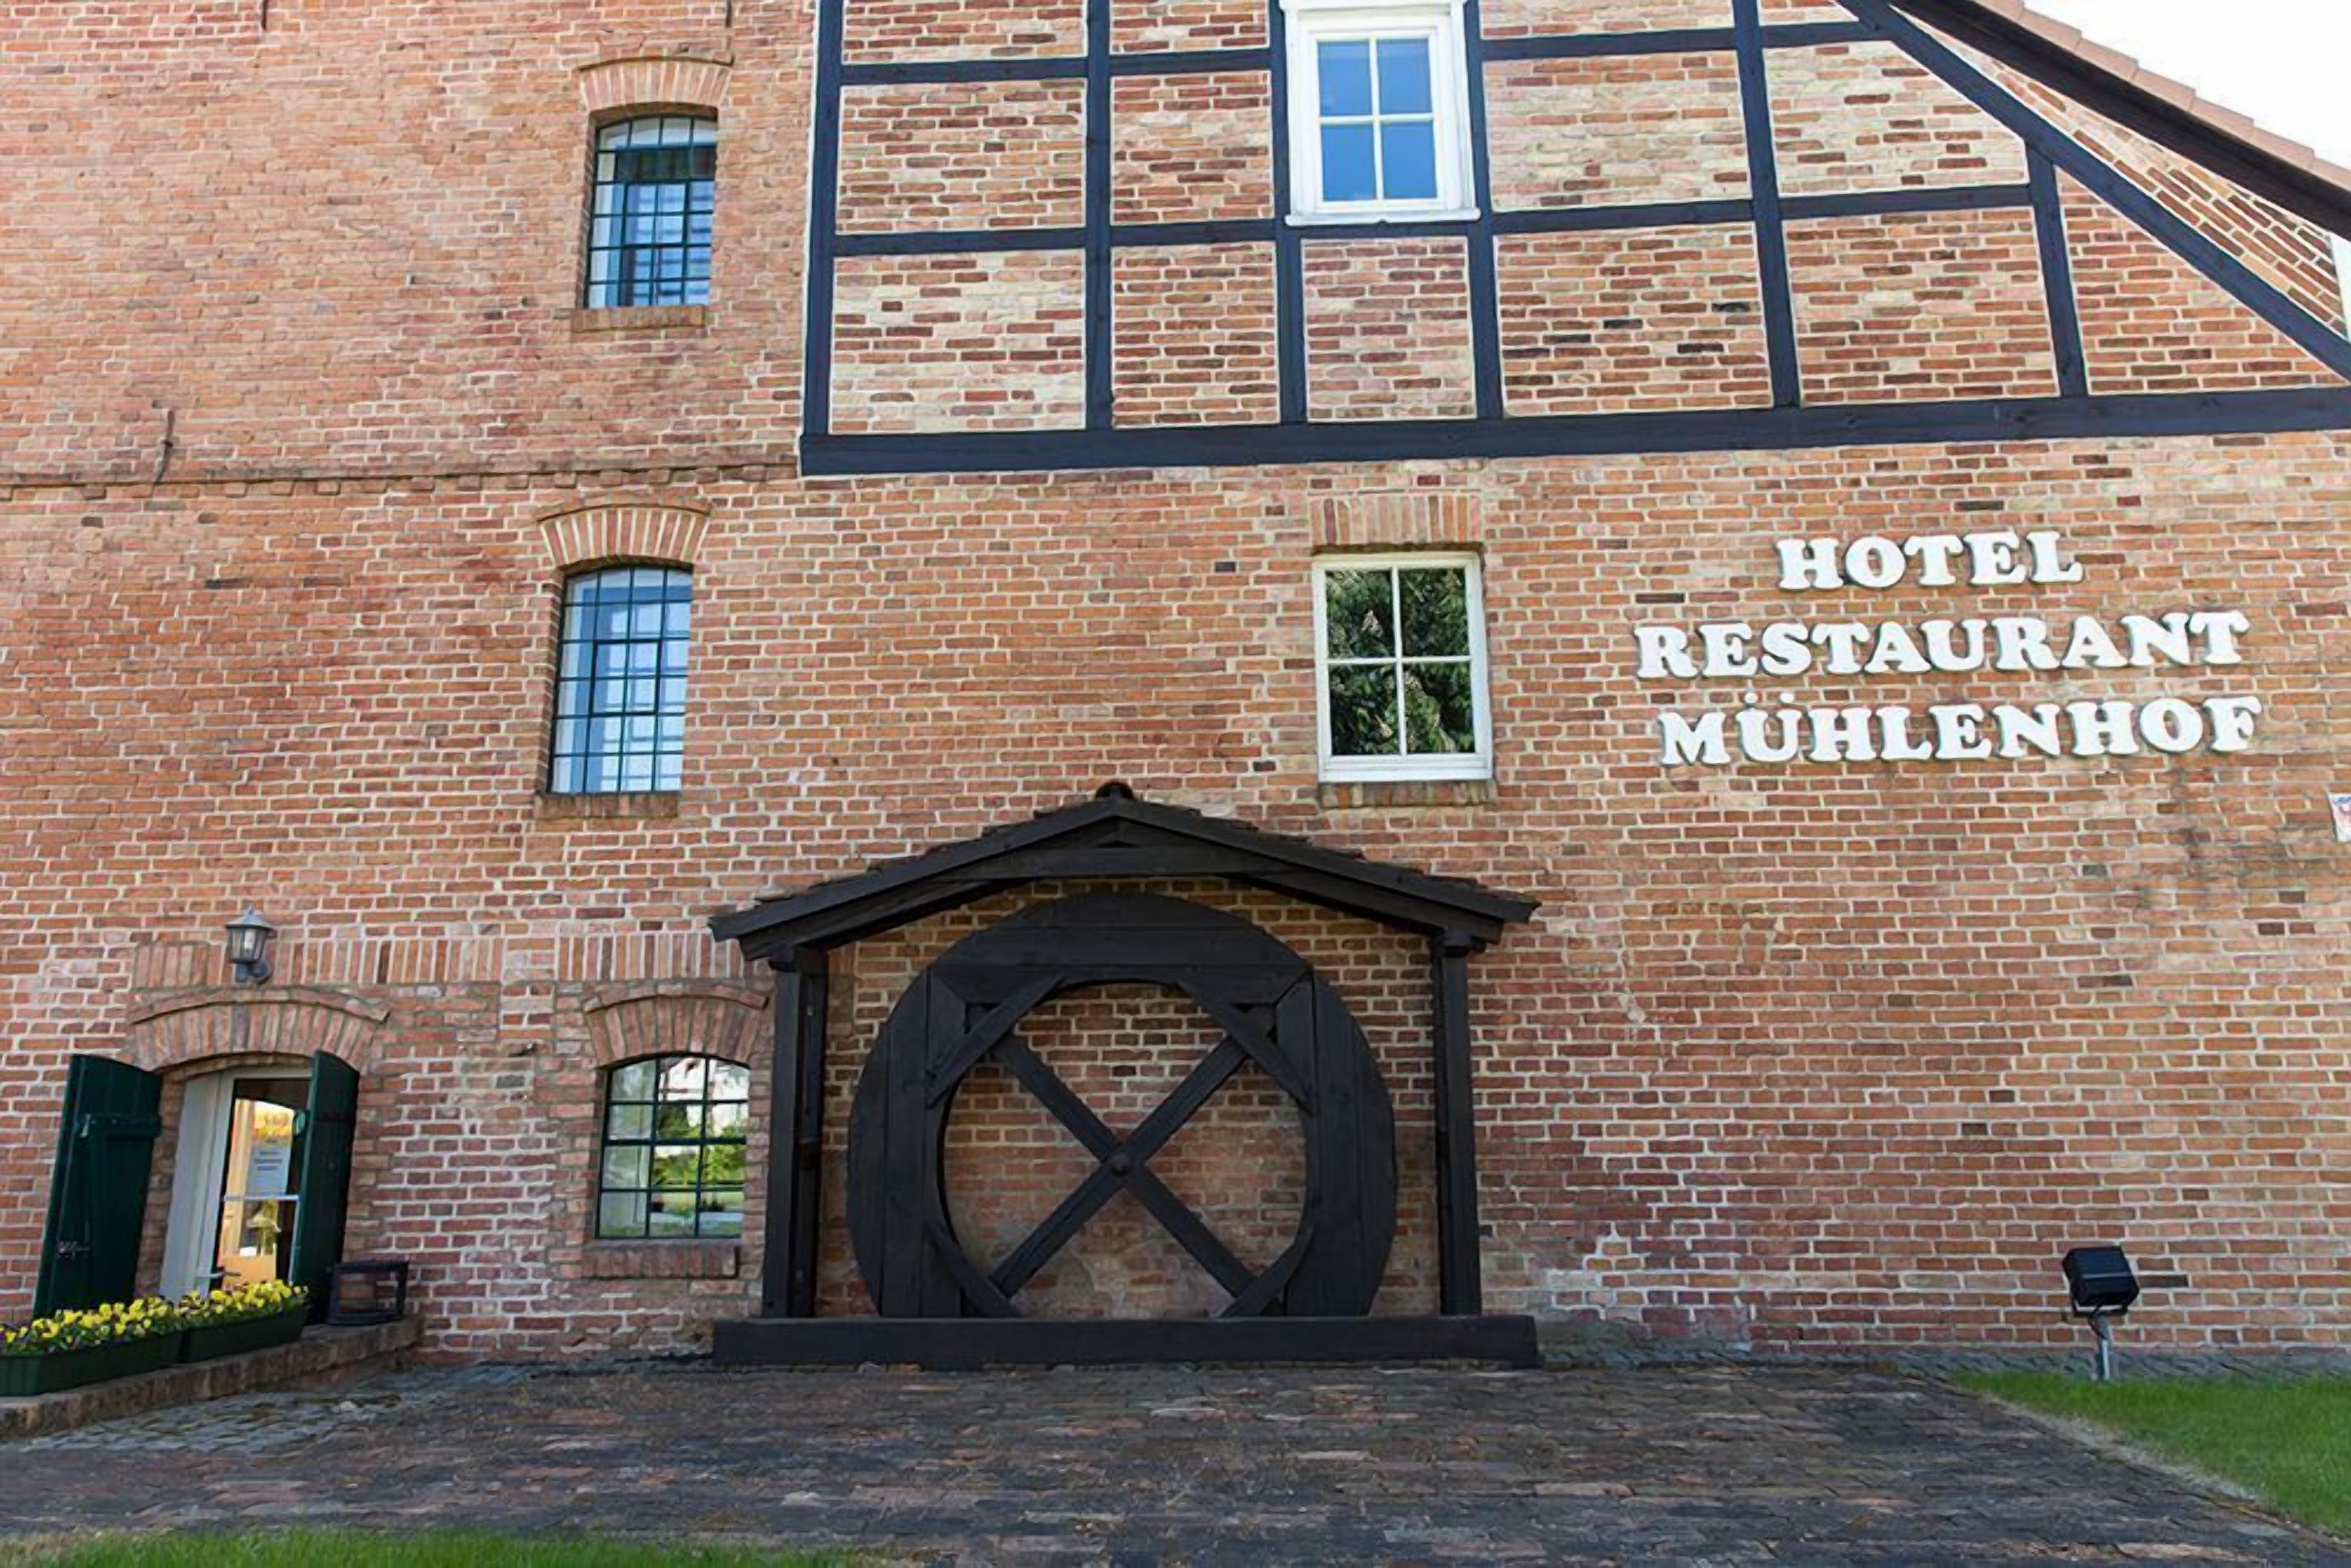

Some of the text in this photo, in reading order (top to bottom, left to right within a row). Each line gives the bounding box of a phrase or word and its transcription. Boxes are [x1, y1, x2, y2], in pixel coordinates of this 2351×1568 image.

[1776, 531, 2083, 589] HOTEL
[1634, 610, 2250, 678] RESTAURANT
[1657, 691, 2262, 765] MÜHLENHOF
